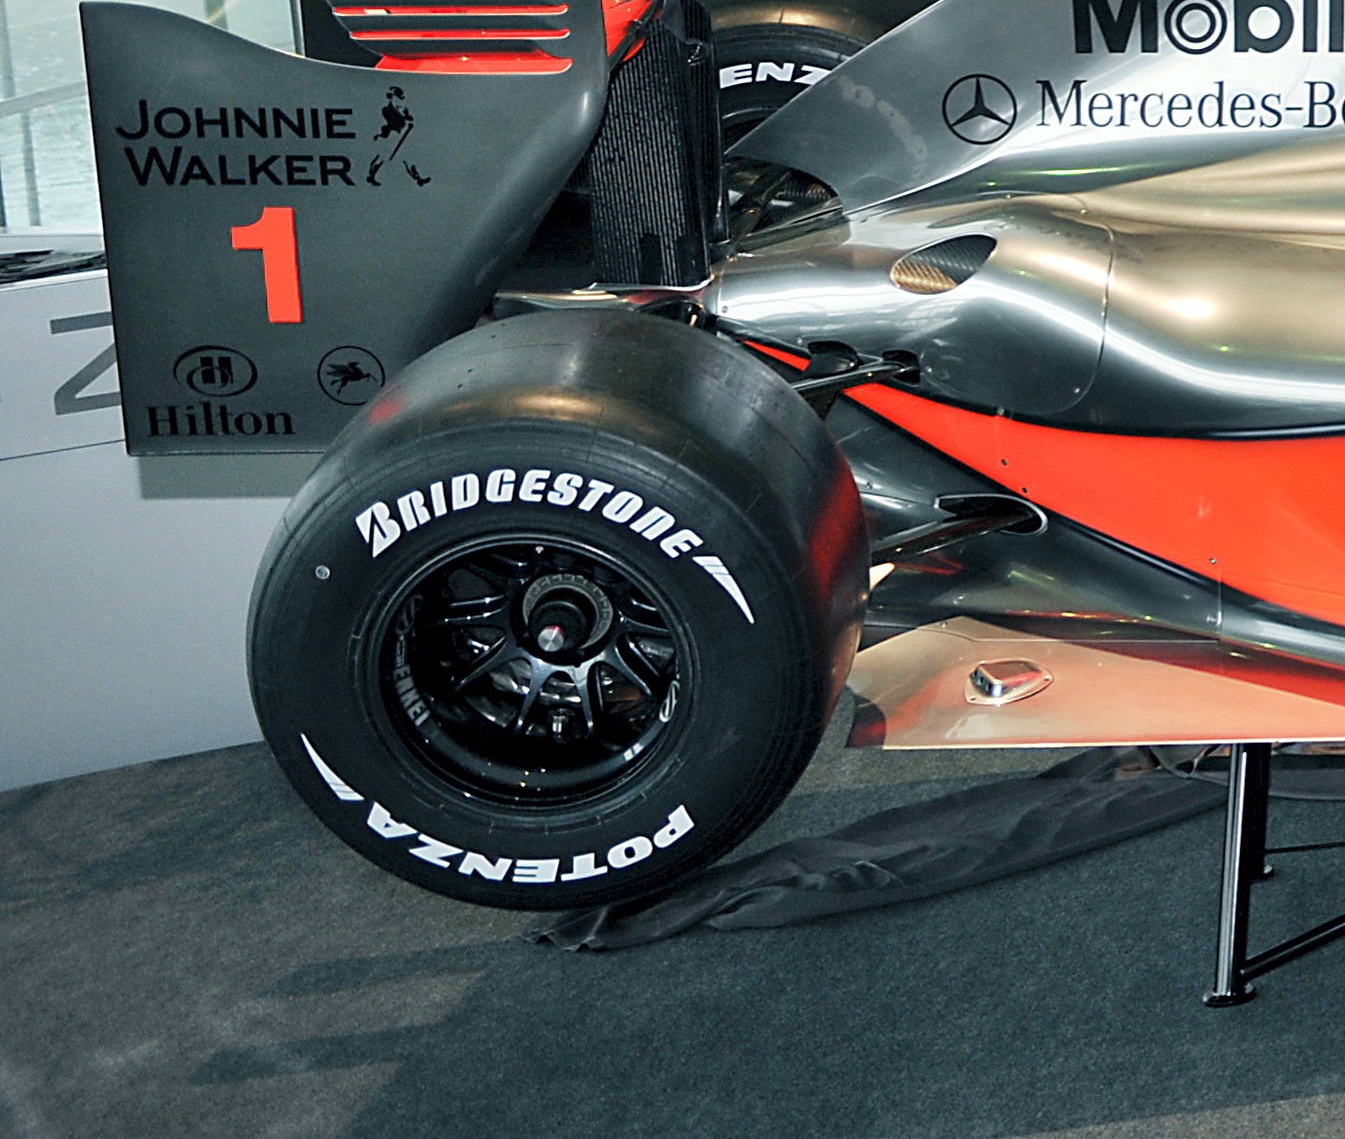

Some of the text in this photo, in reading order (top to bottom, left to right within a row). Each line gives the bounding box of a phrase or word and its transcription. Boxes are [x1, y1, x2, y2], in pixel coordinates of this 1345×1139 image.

[115, 99, 356, 140] JOHNNIE
[124, 146, 356, 187] WALKER
[230, 206, 302, 323] 1
[147, 401, 296, 437] Hilton
[355, 468, 704, 559] BRIDGESTONE
[366, 804, 696, 884] POTENZA
